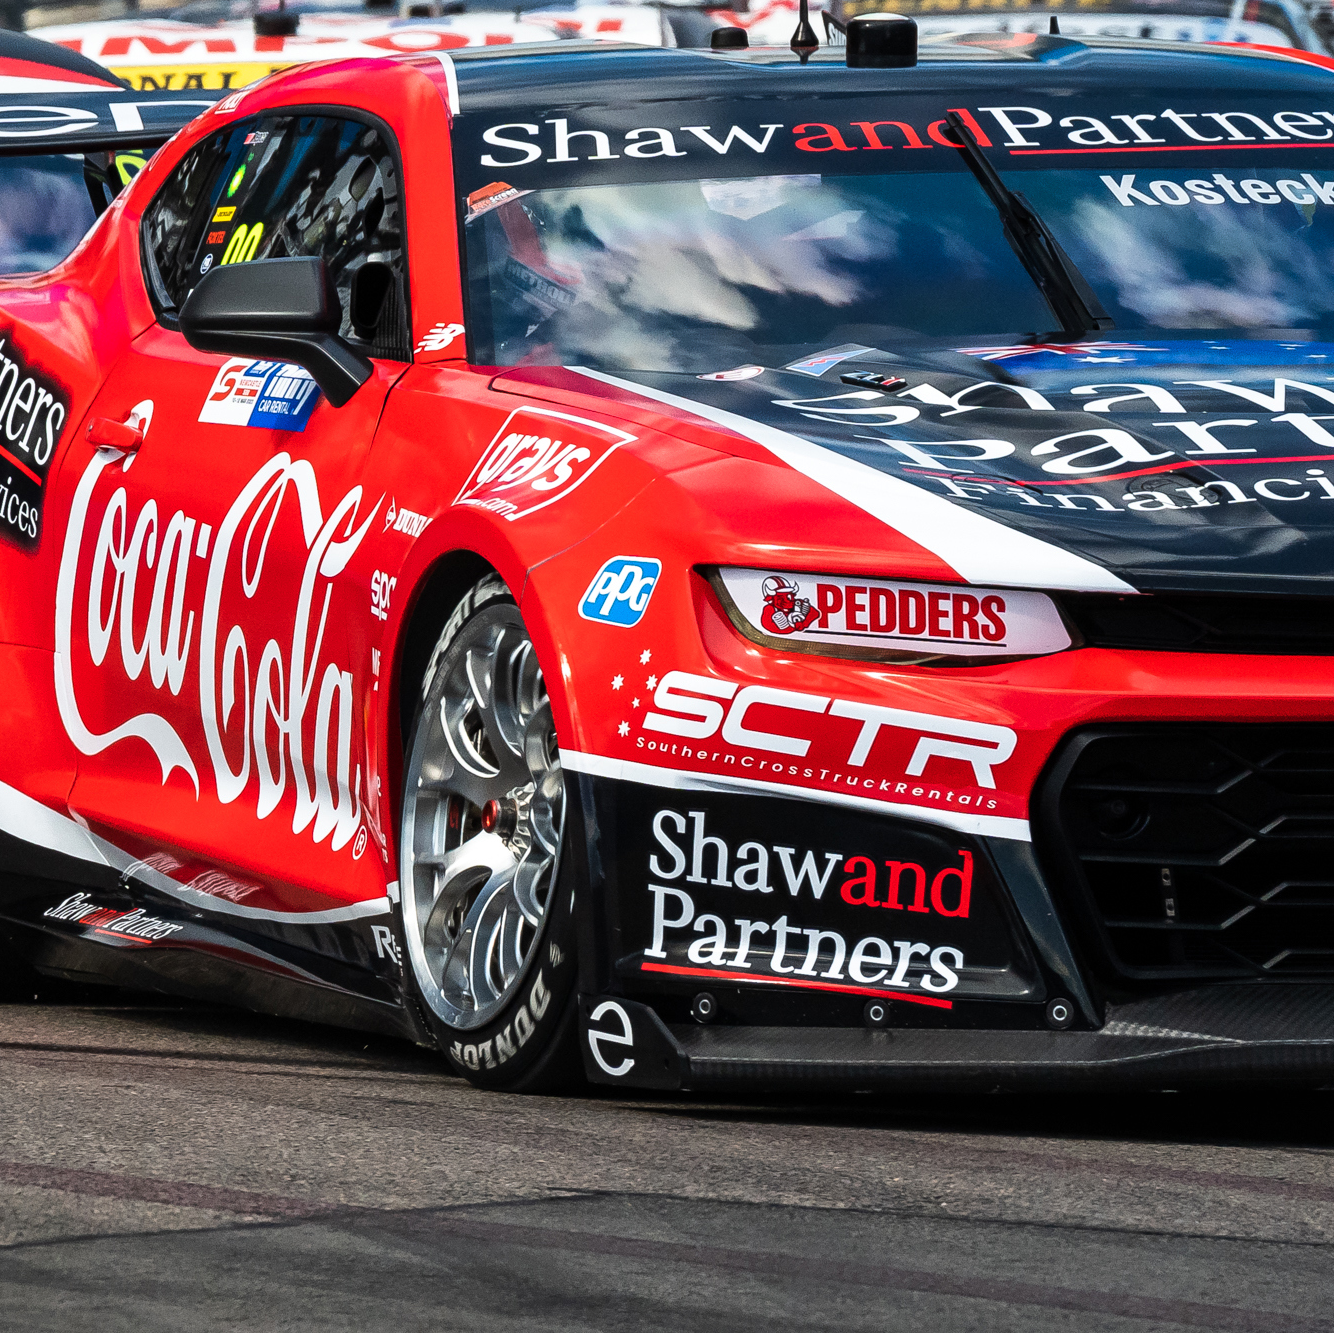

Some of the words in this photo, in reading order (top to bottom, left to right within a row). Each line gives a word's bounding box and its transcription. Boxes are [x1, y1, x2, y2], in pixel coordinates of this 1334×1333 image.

[474, 426, 595, 492] grays
[815, 583, 1008, 643] PEDDERS
[641, 670, 1019, 790] SCTR
[643, 883, 965, 994] Partners
